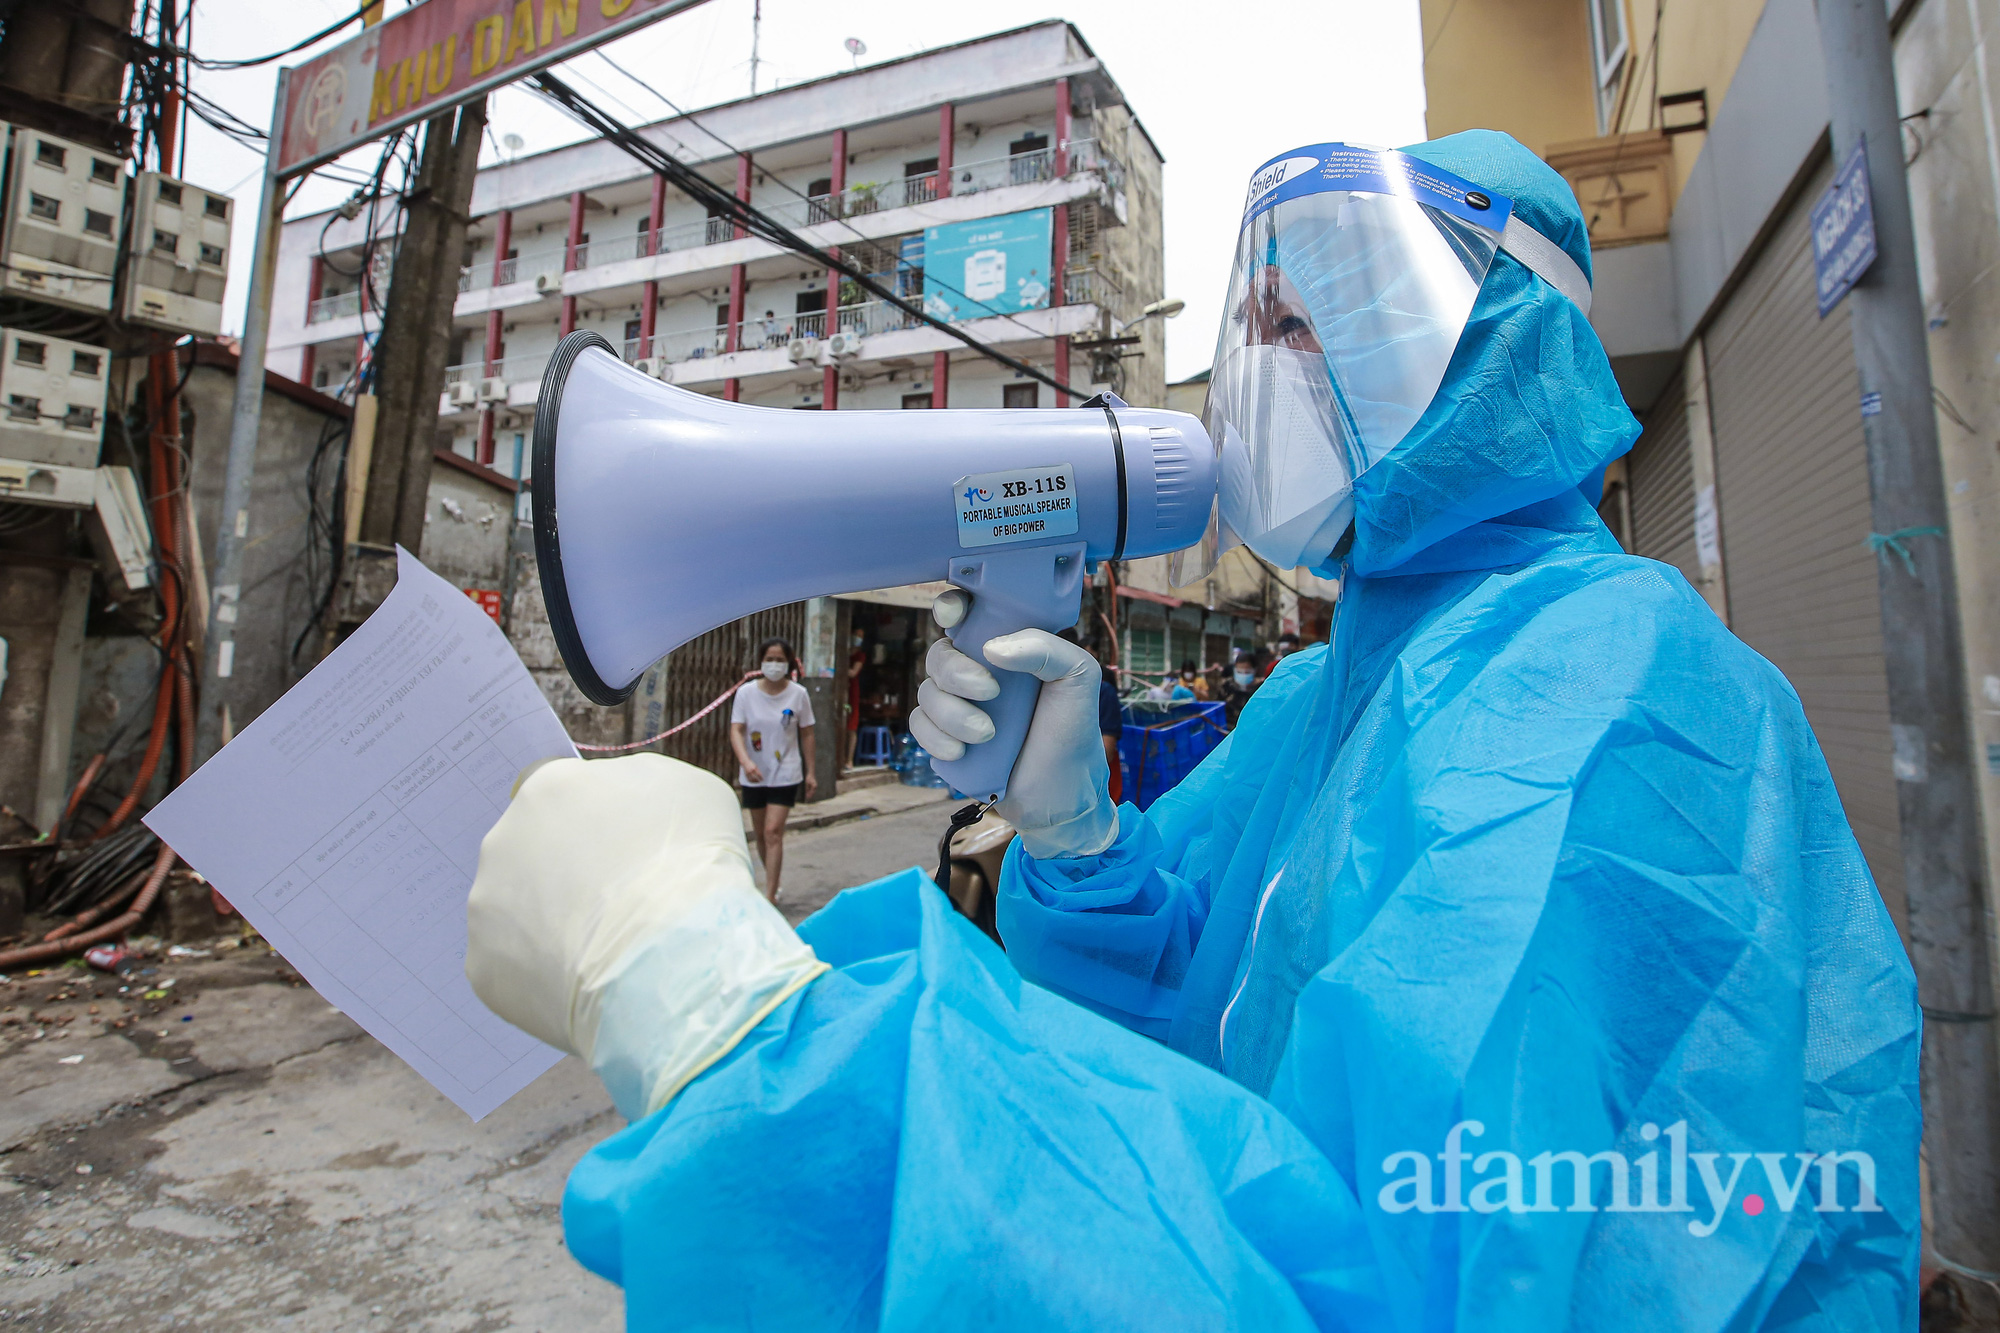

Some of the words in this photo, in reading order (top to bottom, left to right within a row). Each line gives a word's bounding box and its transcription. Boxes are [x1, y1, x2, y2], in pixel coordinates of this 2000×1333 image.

[369, 32, 457, 122] KHU
[1250, 162, 1287, 201] Shield
[1414, 175, 1457, 196] transportation
[1416, 172, 1439, 184] protect
[1440, 180, 1449, 188] the
[1416, 181, 1431, 190] from
[1432, 187, 1452, 199] before
[1261, 193, 1278, 208] Mask
[1002, 475, 1066, 498] XB-11S
[963, 507, 1002, 523] PORTABLE
[1003, 502, 1036, 518] MUSICAL
[1037, 497, 1071, 513] SPEAKER
[993, 526, 1003, 537] OF
[1004, 524, 1017, 535] BIG
[1018, 520, 1045, 534] POWER
